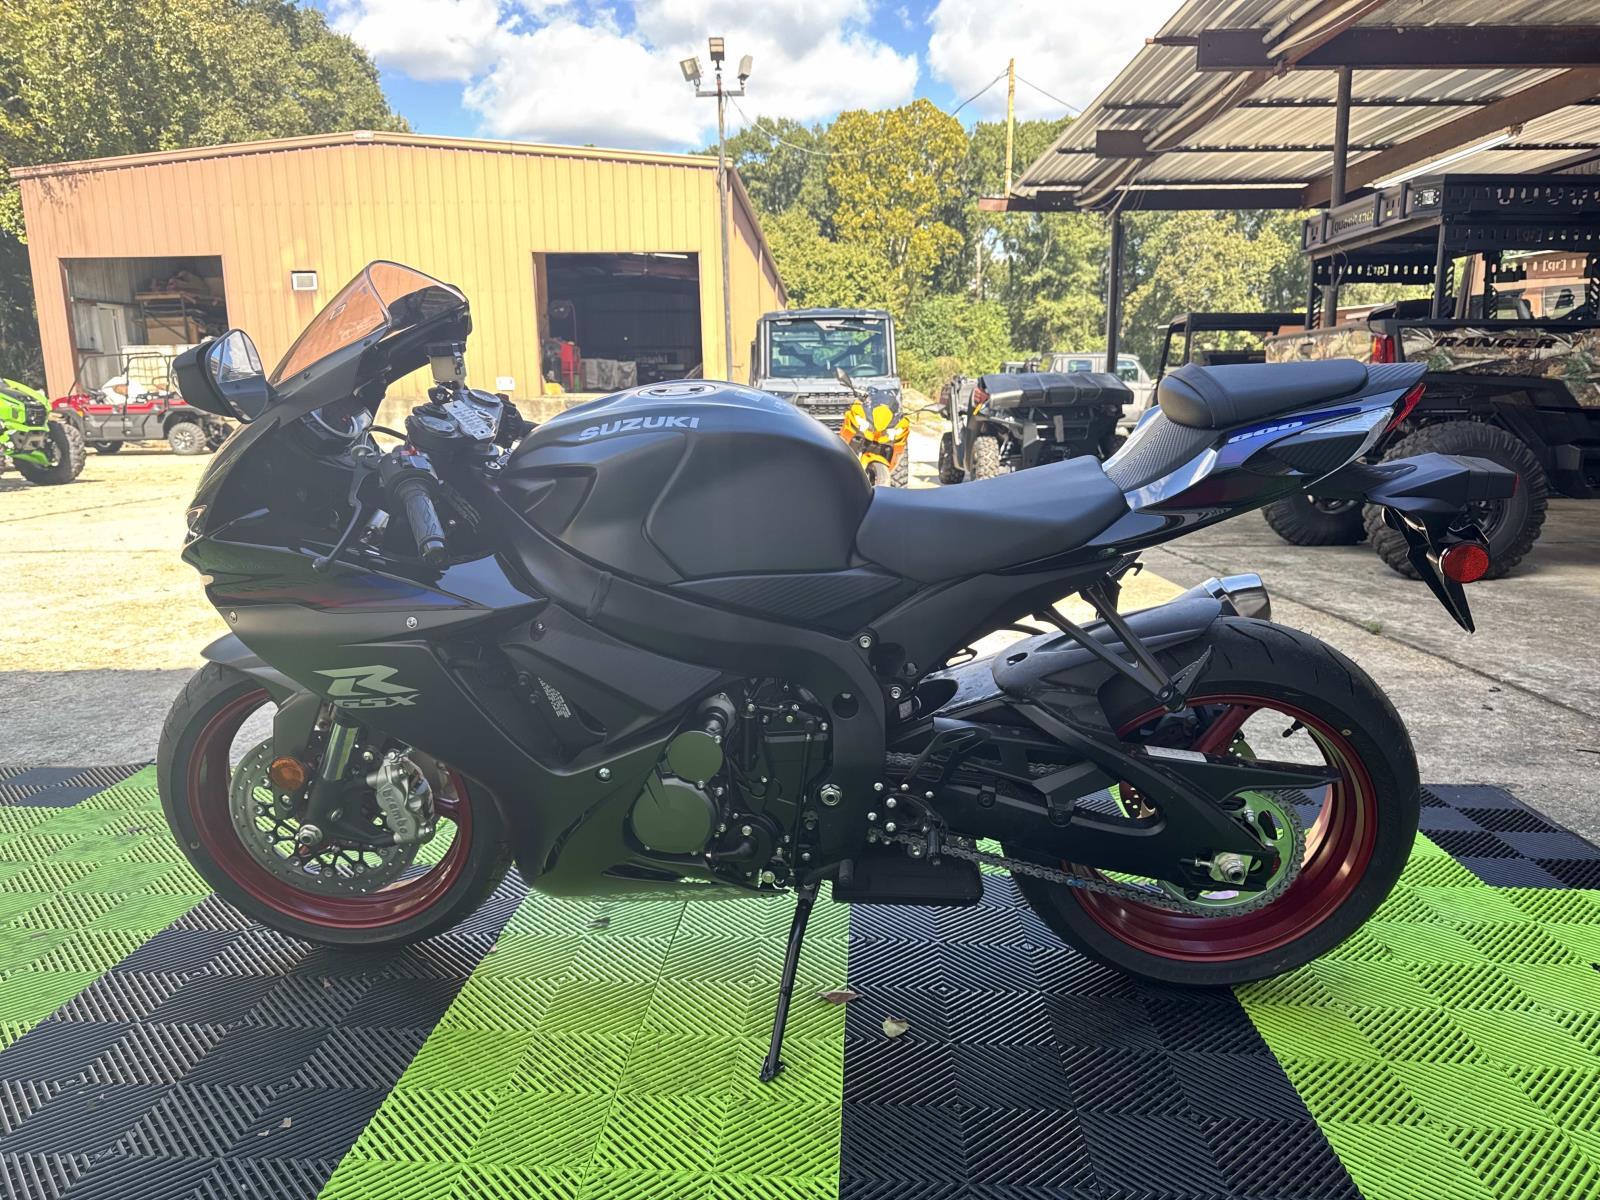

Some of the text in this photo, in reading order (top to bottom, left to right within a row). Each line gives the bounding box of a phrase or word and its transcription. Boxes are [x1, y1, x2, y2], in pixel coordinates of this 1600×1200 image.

[1435, 336, 1558, 349] RANGER
[578, 415, 700, 441] SUZUKI
[312, 664, 419, 697] R
[333, 693, 421, 709] GSX
[382, 788, 409, 835] brembo
